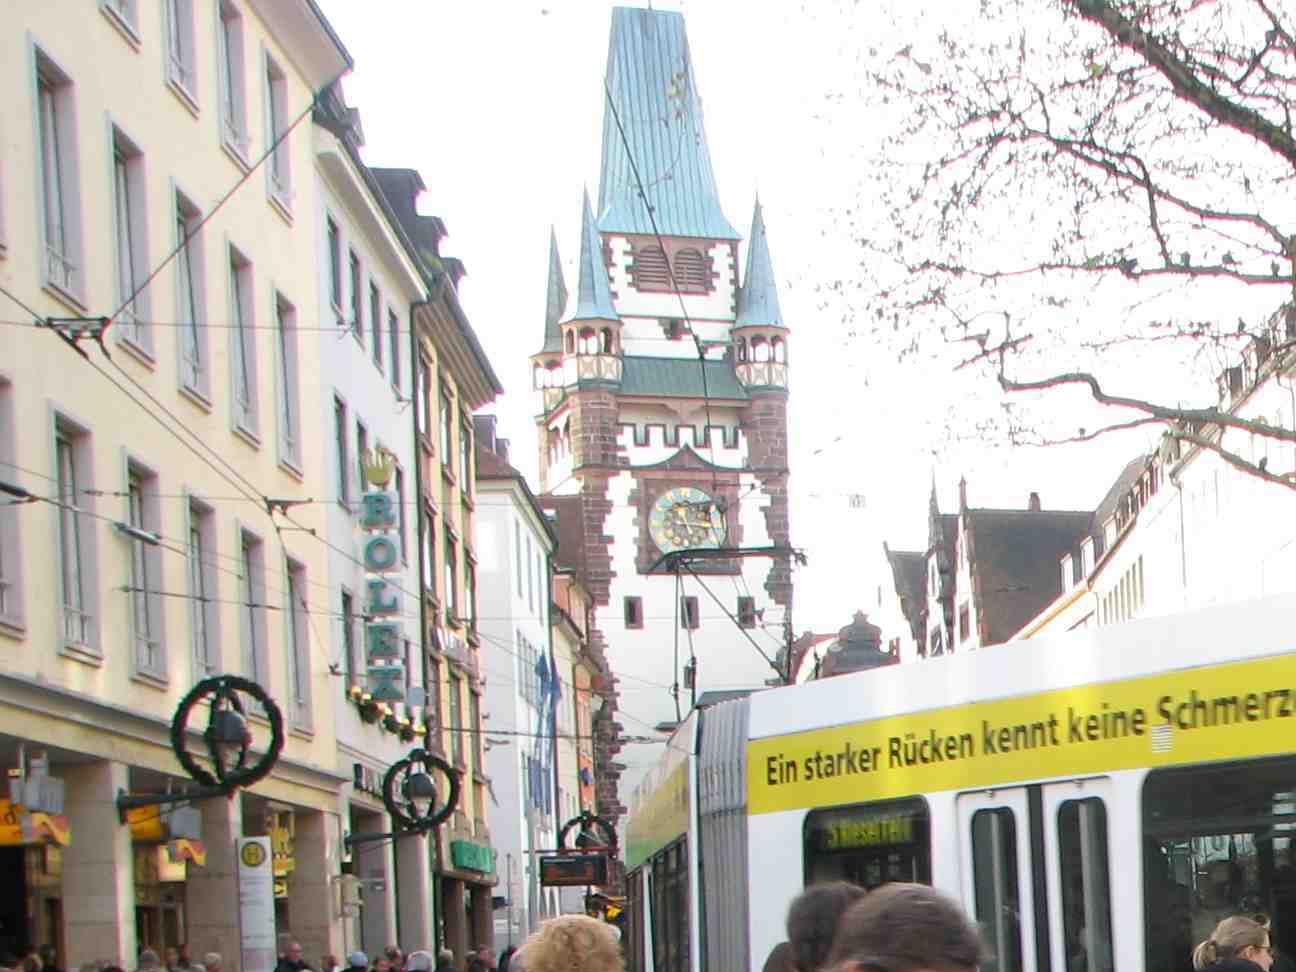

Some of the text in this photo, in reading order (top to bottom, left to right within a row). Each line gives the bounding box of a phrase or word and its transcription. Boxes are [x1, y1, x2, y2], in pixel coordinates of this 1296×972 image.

[767, 755, 797, 785] Ein
[804, 741, 881, 781] starker
[889, 728, 974, 769] Rücken
[983, 713, 1059, 757] kennt
[1068, 702, 1146, 744] keine
